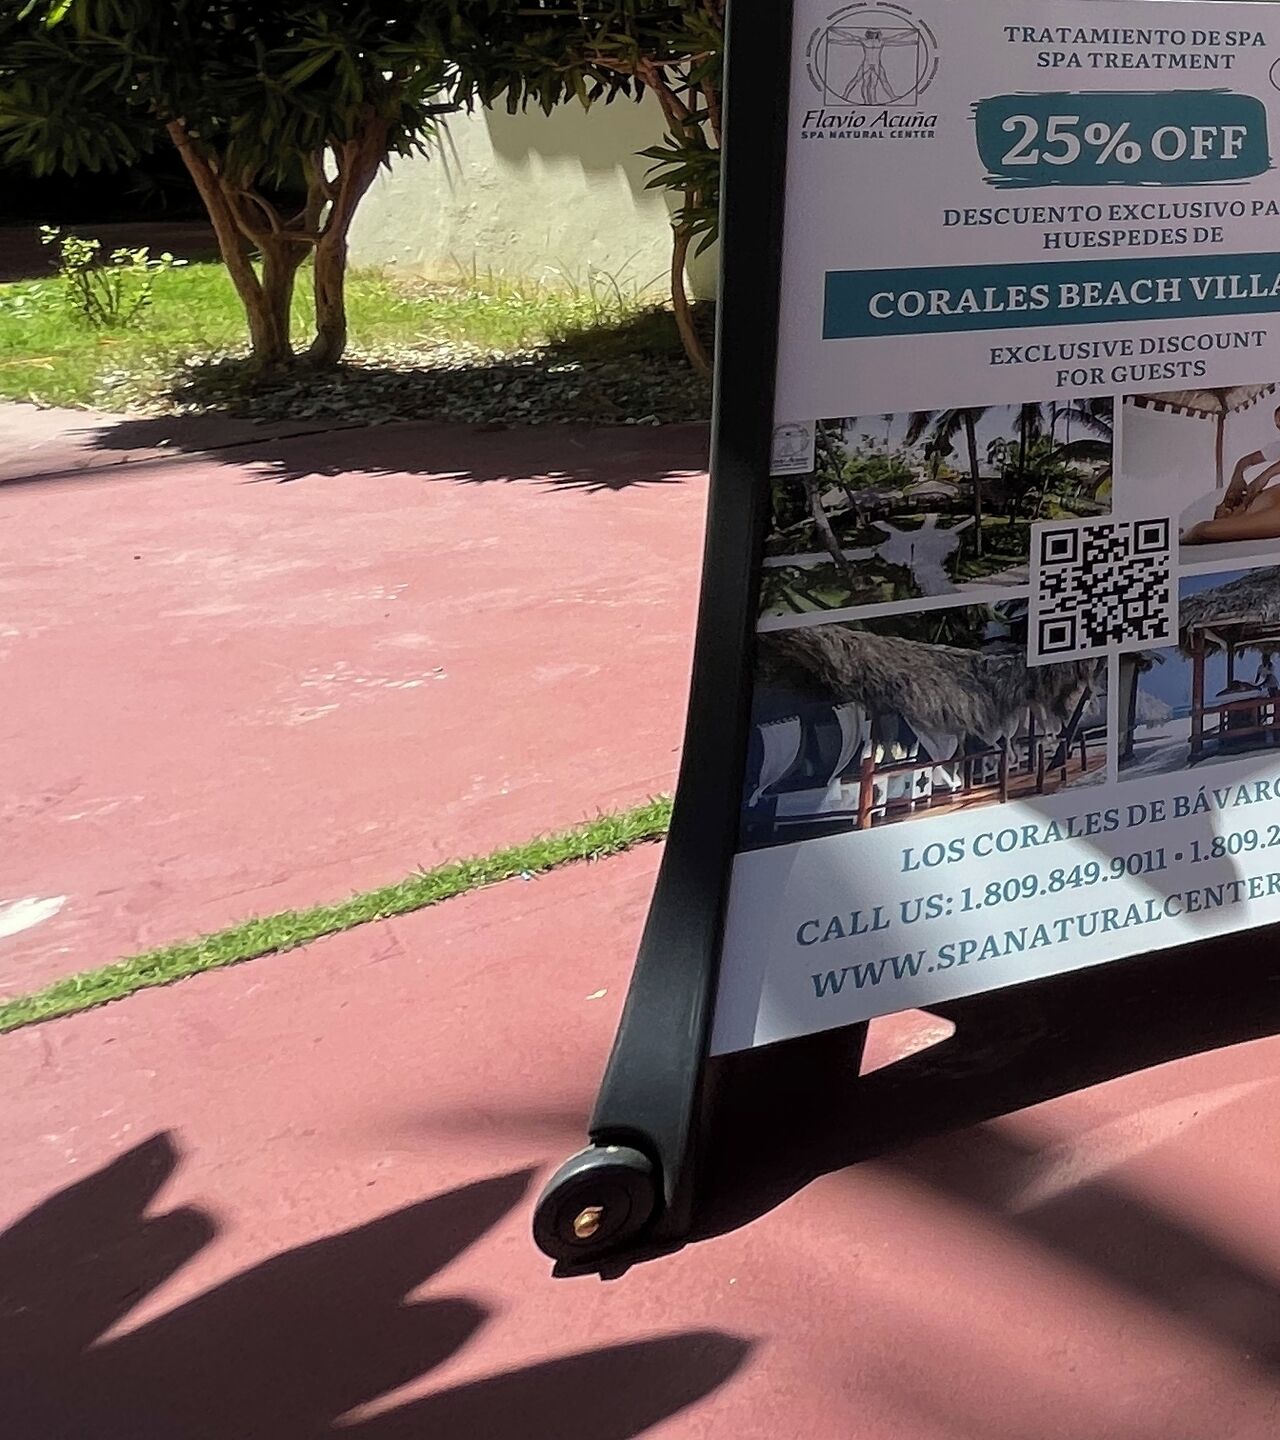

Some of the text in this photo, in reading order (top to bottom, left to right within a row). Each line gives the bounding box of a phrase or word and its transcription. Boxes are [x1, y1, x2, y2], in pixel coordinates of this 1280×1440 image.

[1003, 26, 1267, 47] TRATAMIENTO DE SPA
[1036, 51, 1236, 70] SPA TREATMENT
[802, 109, 938, 129] Flavio Acuña
[801, 130, 935, 139] SPA NATURAL CENTER
[1001, 115, 1248, 166] 25% OFF
[943, 205, 1102, 227] DESCUENTO
[1108, 200, 1246, 222] EXCLUSIVO
[1042, 226, 1224, 250] HUESPEDES DE
[868, 283, 1051, 320] CORALES
[1058, 276, 1182, 309] BEACH
[989, 330, 1268, 366] EXCLUSIVE DISCOUNT
[1056, 359, 1207, 388] FOR GUESTS
[901, 837, 967, 873] LOS
[972, 808, 1120, 858] CORALES
[1126, 800, 1167, 829] DE
[796, 905, 891, 947] CALL
[900, 893, 954, 925] US:
[960, 847, 1168, 913] 1.809.849.9011
